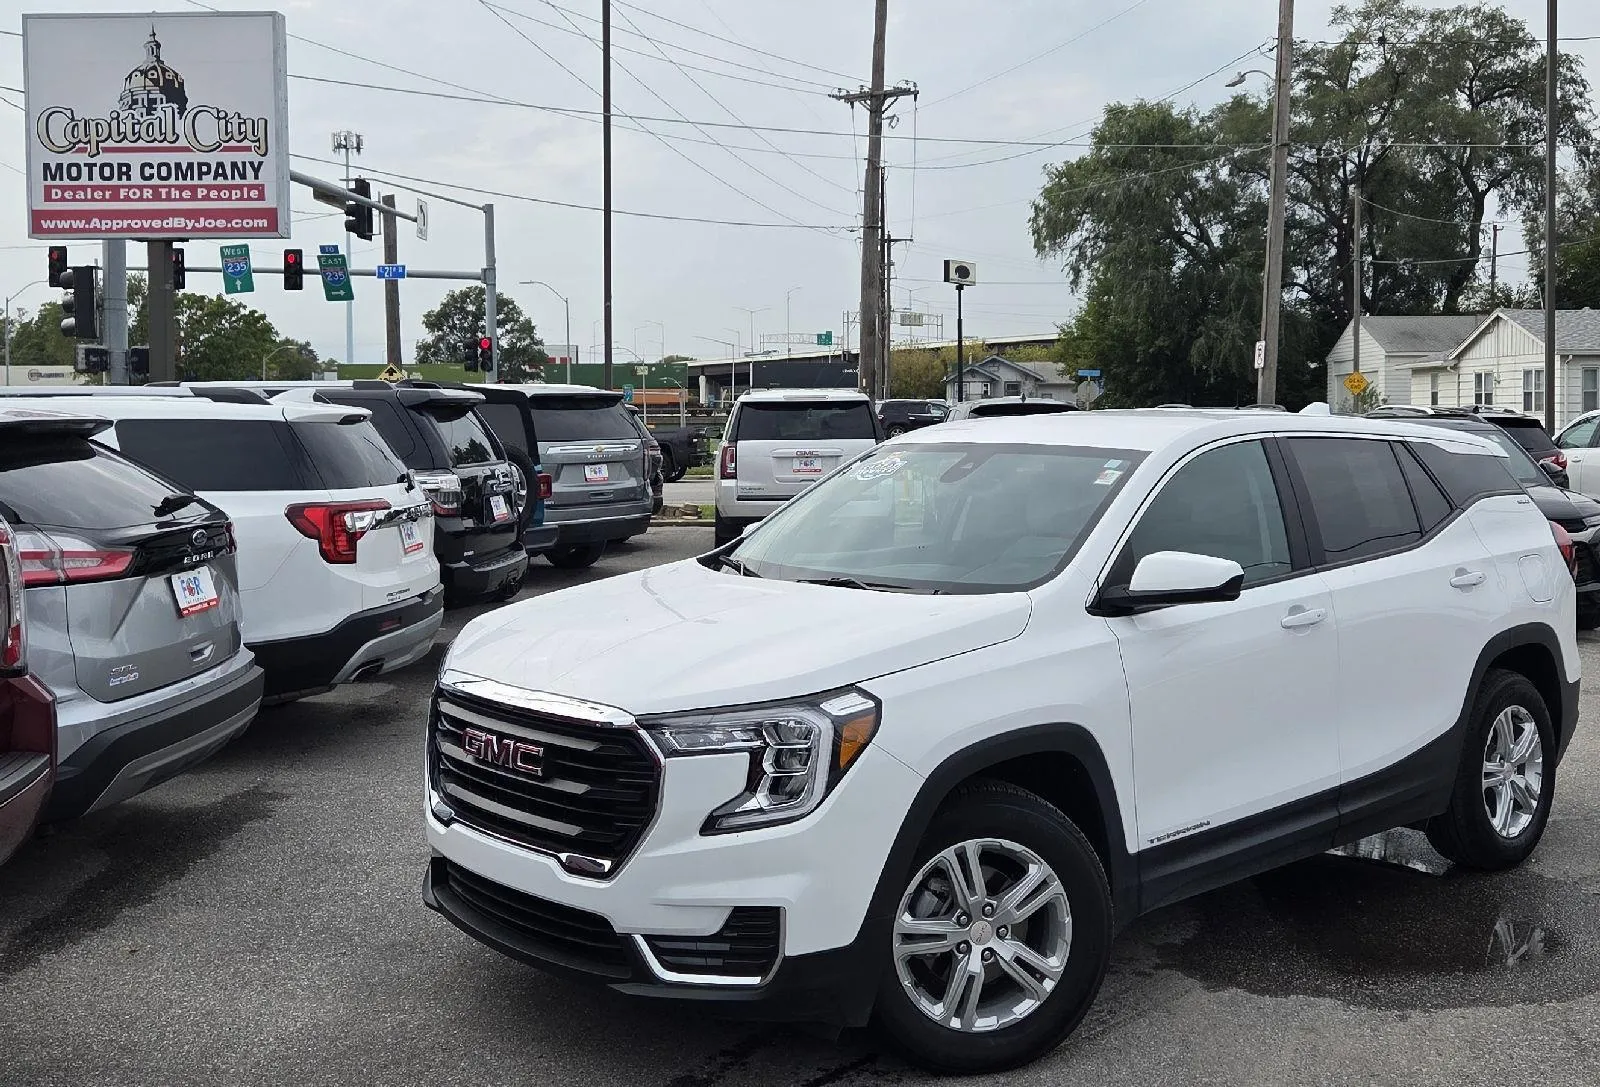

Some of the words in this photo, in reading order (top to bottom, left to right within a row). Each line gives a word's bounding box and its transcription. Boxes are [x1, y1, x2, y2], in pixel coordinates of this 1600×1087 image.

[37, 106, 180, 157] Capital
[184, 105, 268, 156] City
[43, 162, 132, 182] MOTOR
[139, 161, 264, 181] COMPANY
[51, 188, 112, 200] Dealer
[119, 188, 153, 200] FOR
[159, 187, 191, 199] The
[197, 187, 259, 200] People
[41, 217, 268, 230] www.ApprovedByJoe.com
[223, 247, 246, 256] WEST
[227, 262, 247, 273] 235
[321, 257, 342, 265] EAST
[326, 271, 346, 281] 235
[461, 727, 543, 776] GMC
